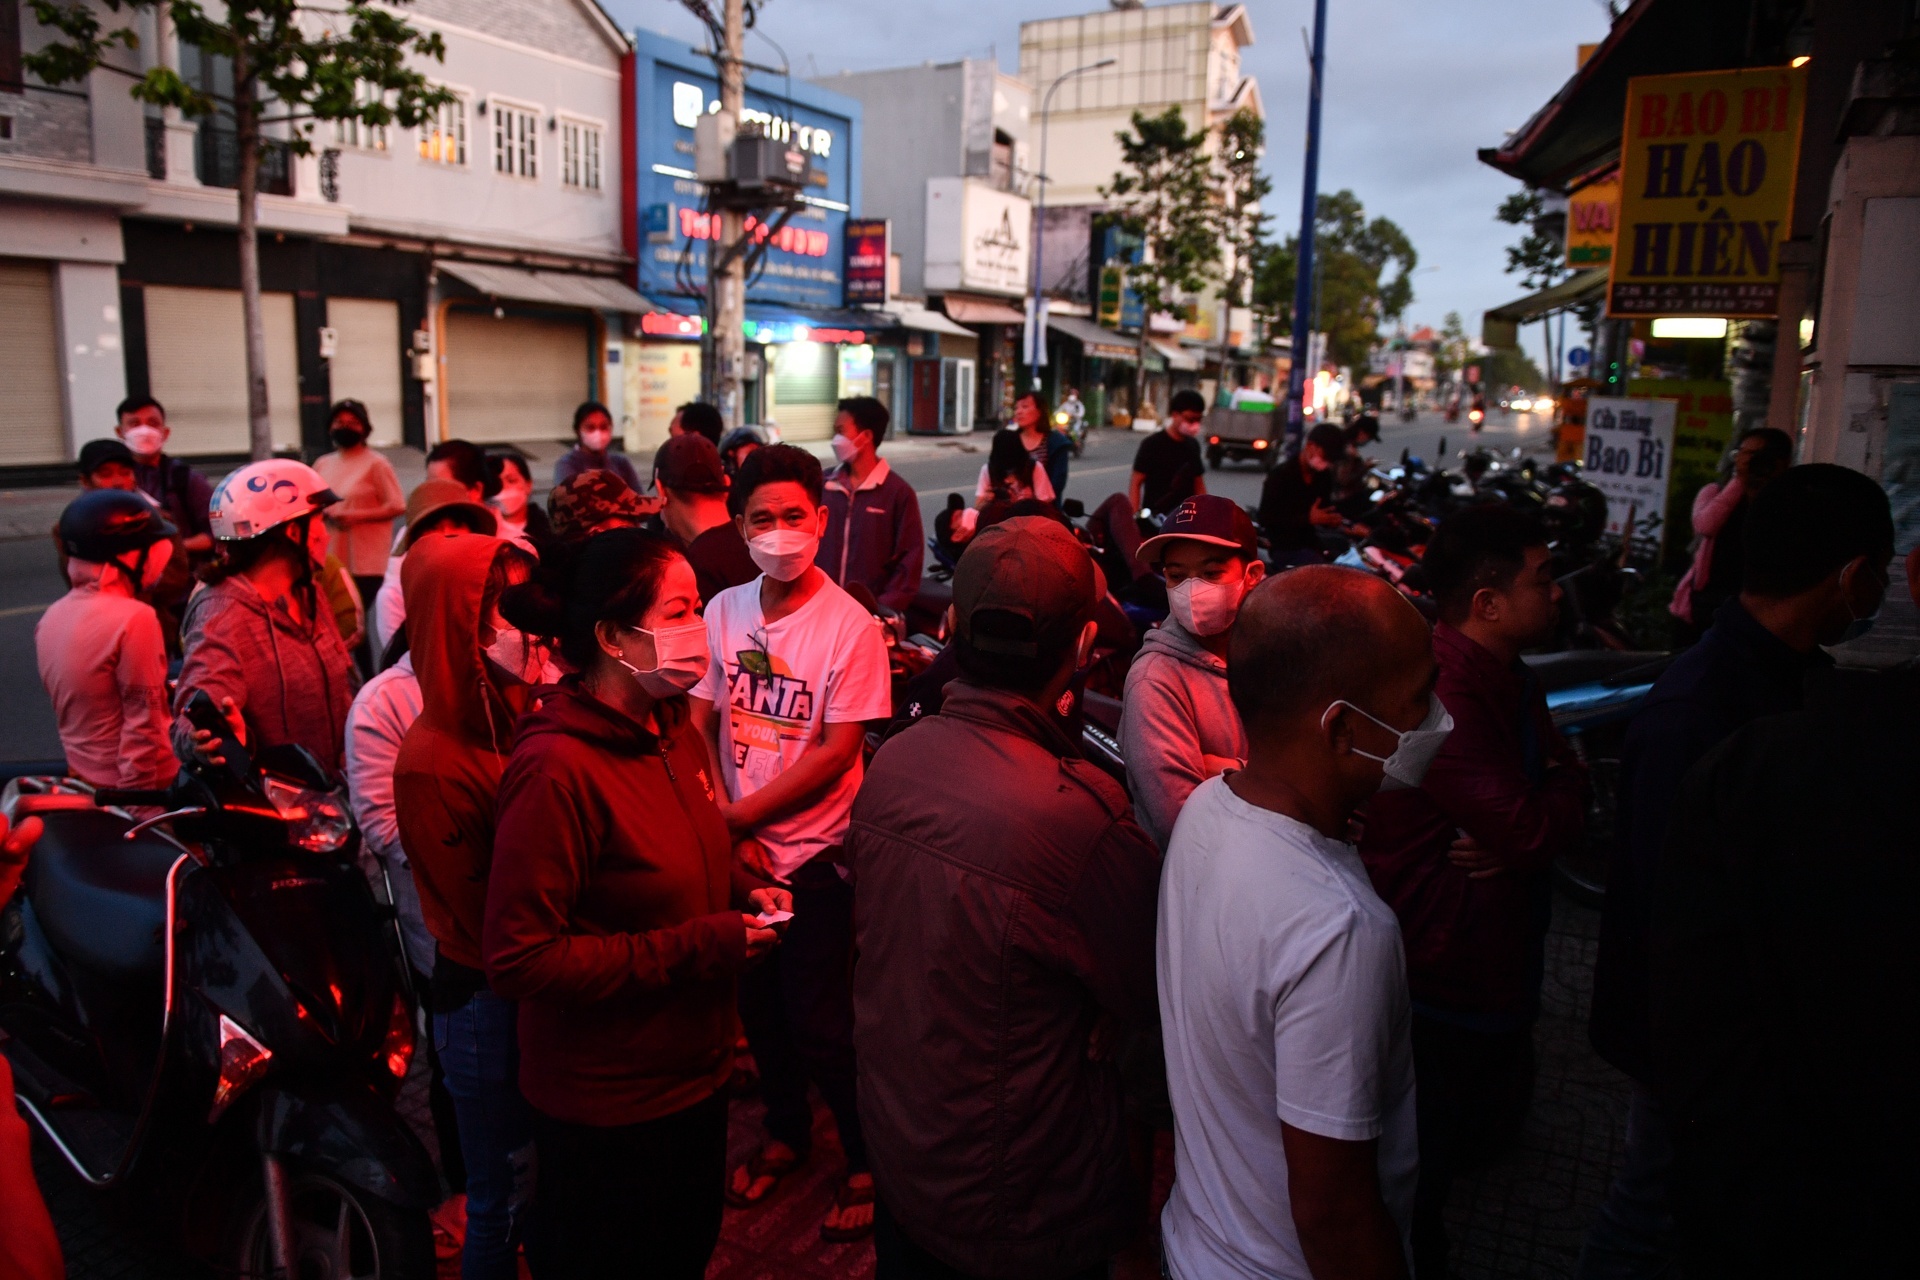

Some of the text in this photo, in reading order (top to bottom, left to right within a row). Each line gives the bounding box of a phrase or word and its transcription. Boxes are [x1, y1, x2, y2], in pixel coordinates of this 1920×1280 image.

[1639, 74, 1792, 138] BAO BÌ
[1643, 140, 1767, 211] HẠO
[1630, 208, 1780, 277] HIÊN
[1586, 435, 1664, 480] Bao Bì
